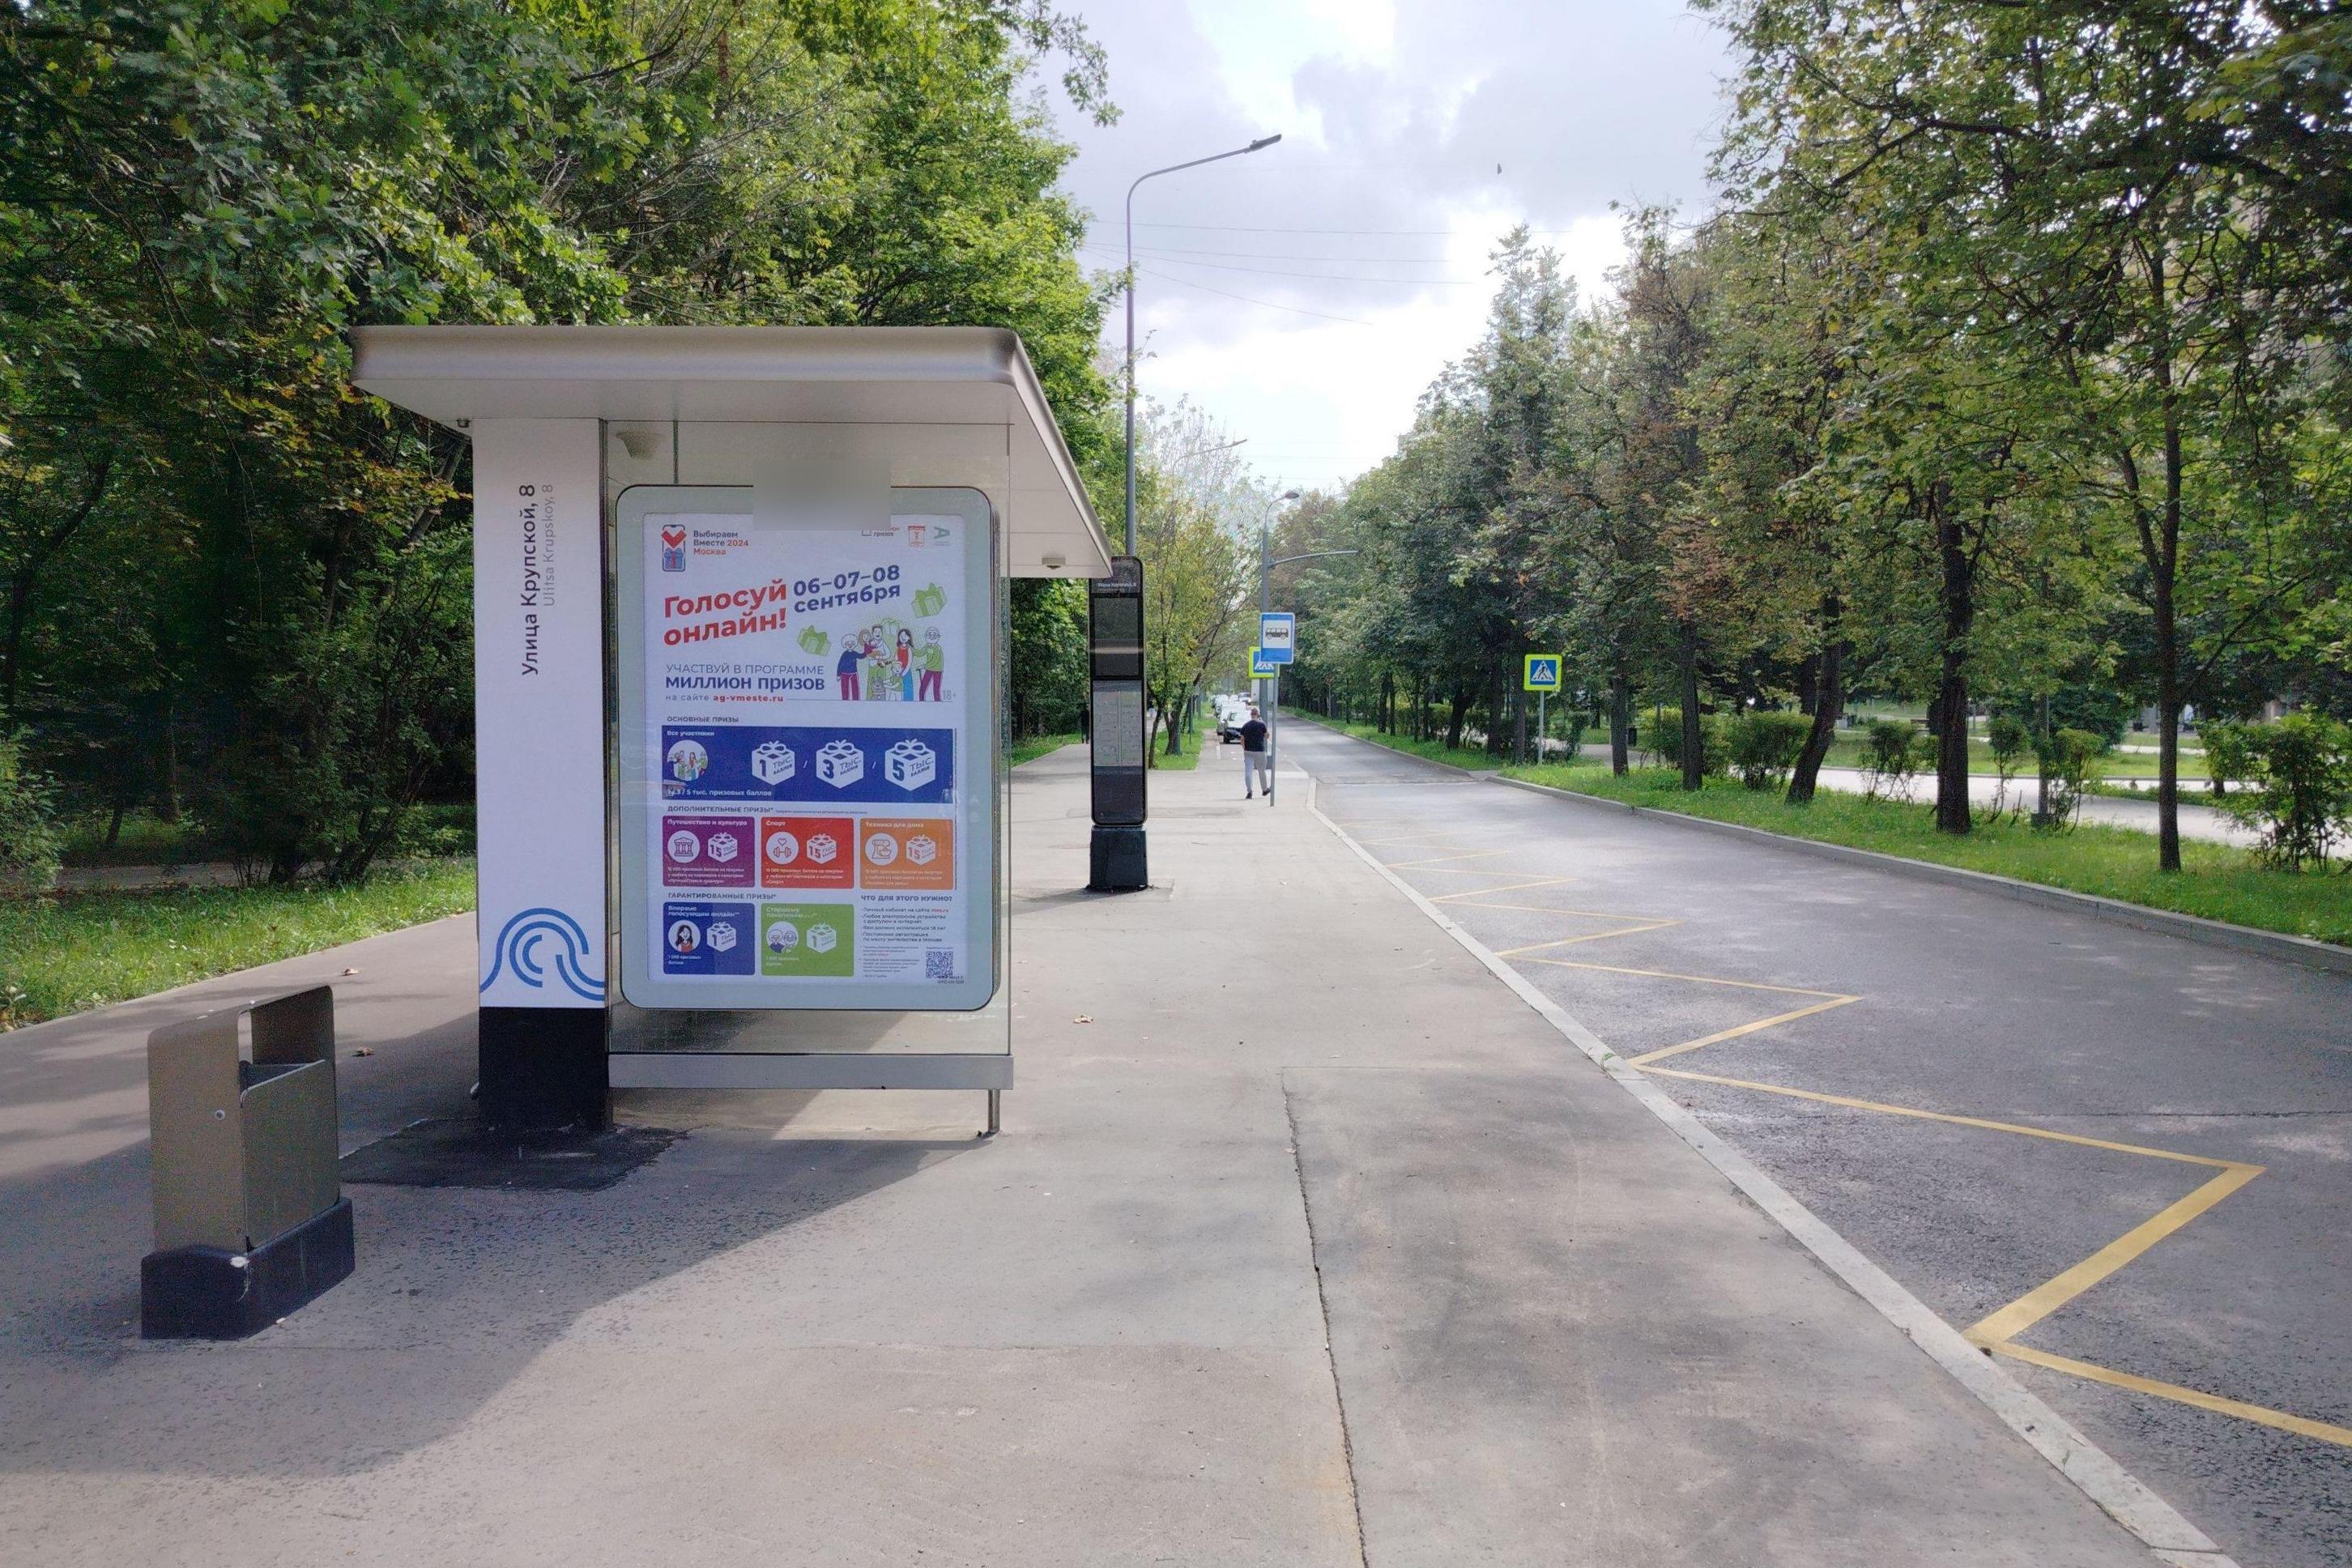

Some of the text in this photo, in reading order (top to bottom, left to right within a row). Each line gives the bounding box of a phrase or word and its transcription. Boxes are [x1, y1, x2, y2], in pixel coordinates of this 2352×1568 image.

[692, 530, 739, 539] Выбираем
[542, 484, 556, 607] Ulitsa Krupskoy, 8
[692, 539, 749, 548] Вместе 2024
[692, 548, 726, 556] Москва
[518, 484, 541, 676] Улица Крупской, 8
[664, 577, 786, 618] Голосуй
[794, 585, 901, 613] сентября
[663, 607, 787, 646] онлайн!
[666, 663, 824, 675] УЧАСТВУЙ В ПРОГРАММЕ
[758, 677, 825, 693] призов
[680, 693, 709, 701] сайте
[713, 694, 784, 703] ag-vmeste.ru
[942, 689, 957, 701] 18+
[759, 758, 767, 778] 1
[823, 758, 834, 779] 3
[892, 757, 905, 782] 5
[710, 844, 722, 858] 15
[808, 846, 821, 859] 15
[908, 846, 920, 859] 15
[712, 933, 718, 947] 1
[812, 935, 817, 948] 1
